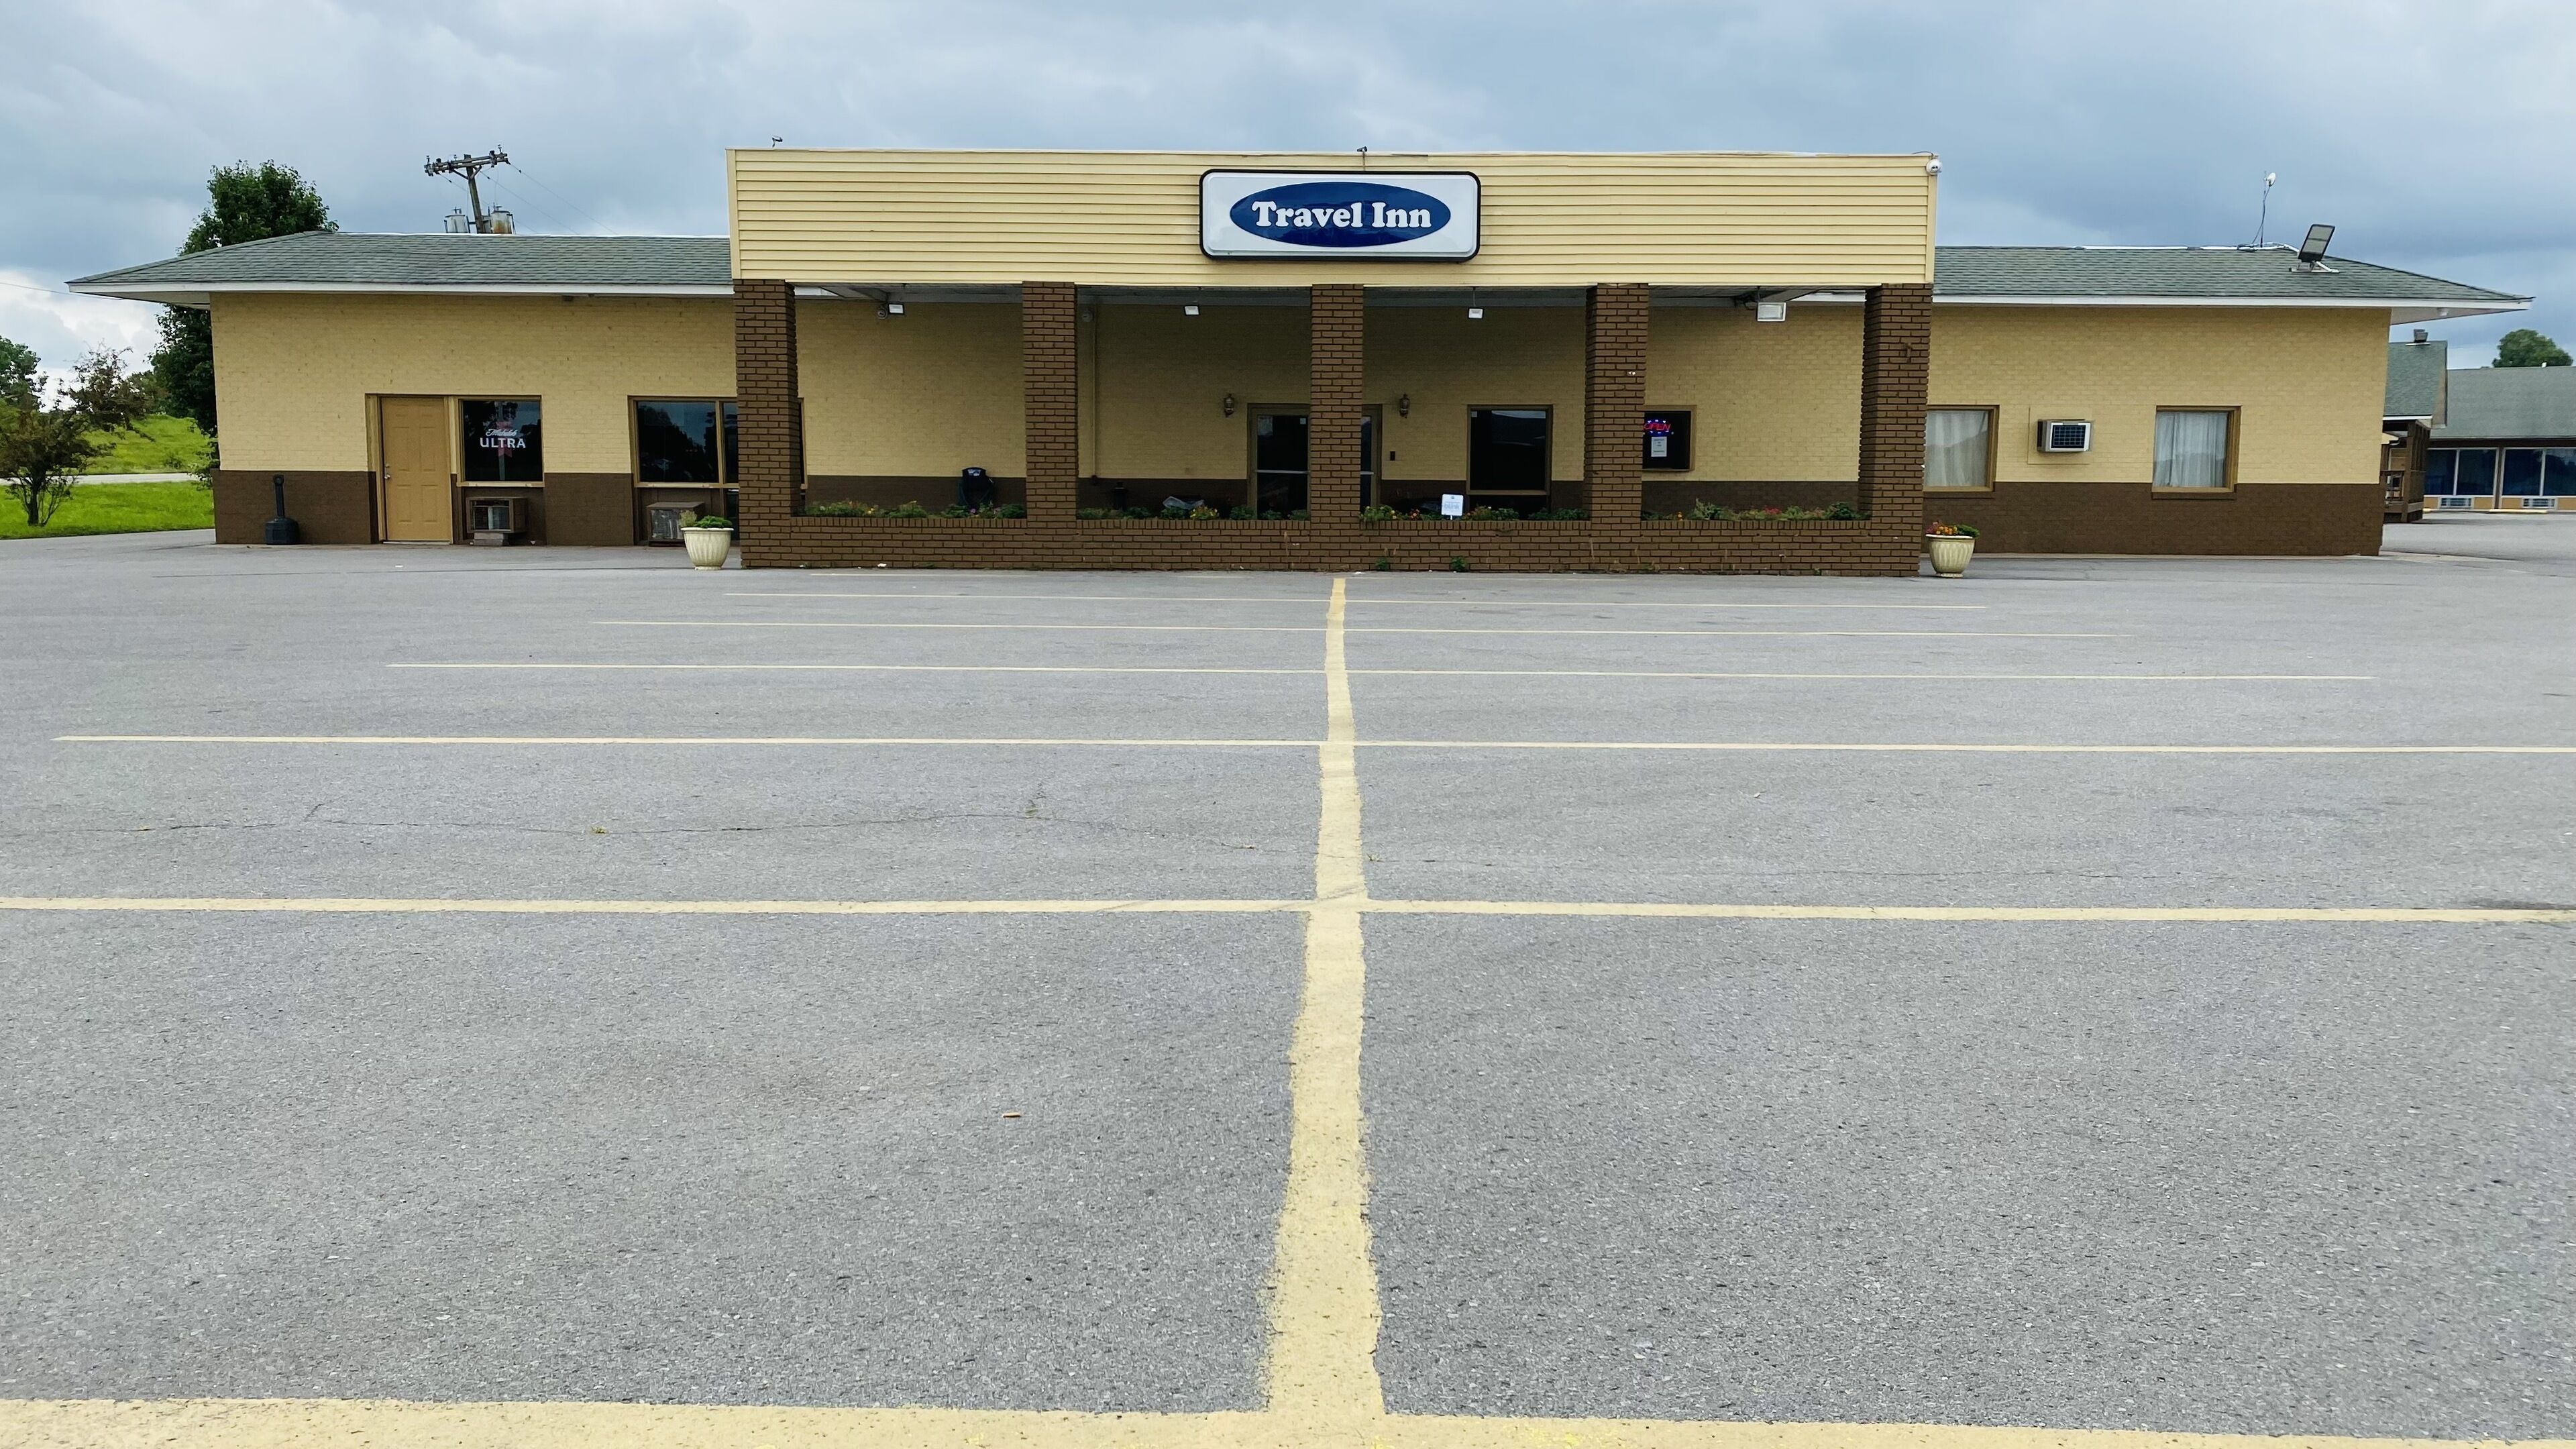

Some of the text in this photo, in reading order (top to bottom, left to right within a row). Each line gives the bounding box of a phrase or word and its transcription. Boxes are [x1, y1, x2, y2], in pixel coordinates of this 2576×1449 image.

[1252, 201, 1433, 229] Travel Inn
[1644, 422, 1672, 431] OPEN
[480, 437, 526, 449] ULTRA
